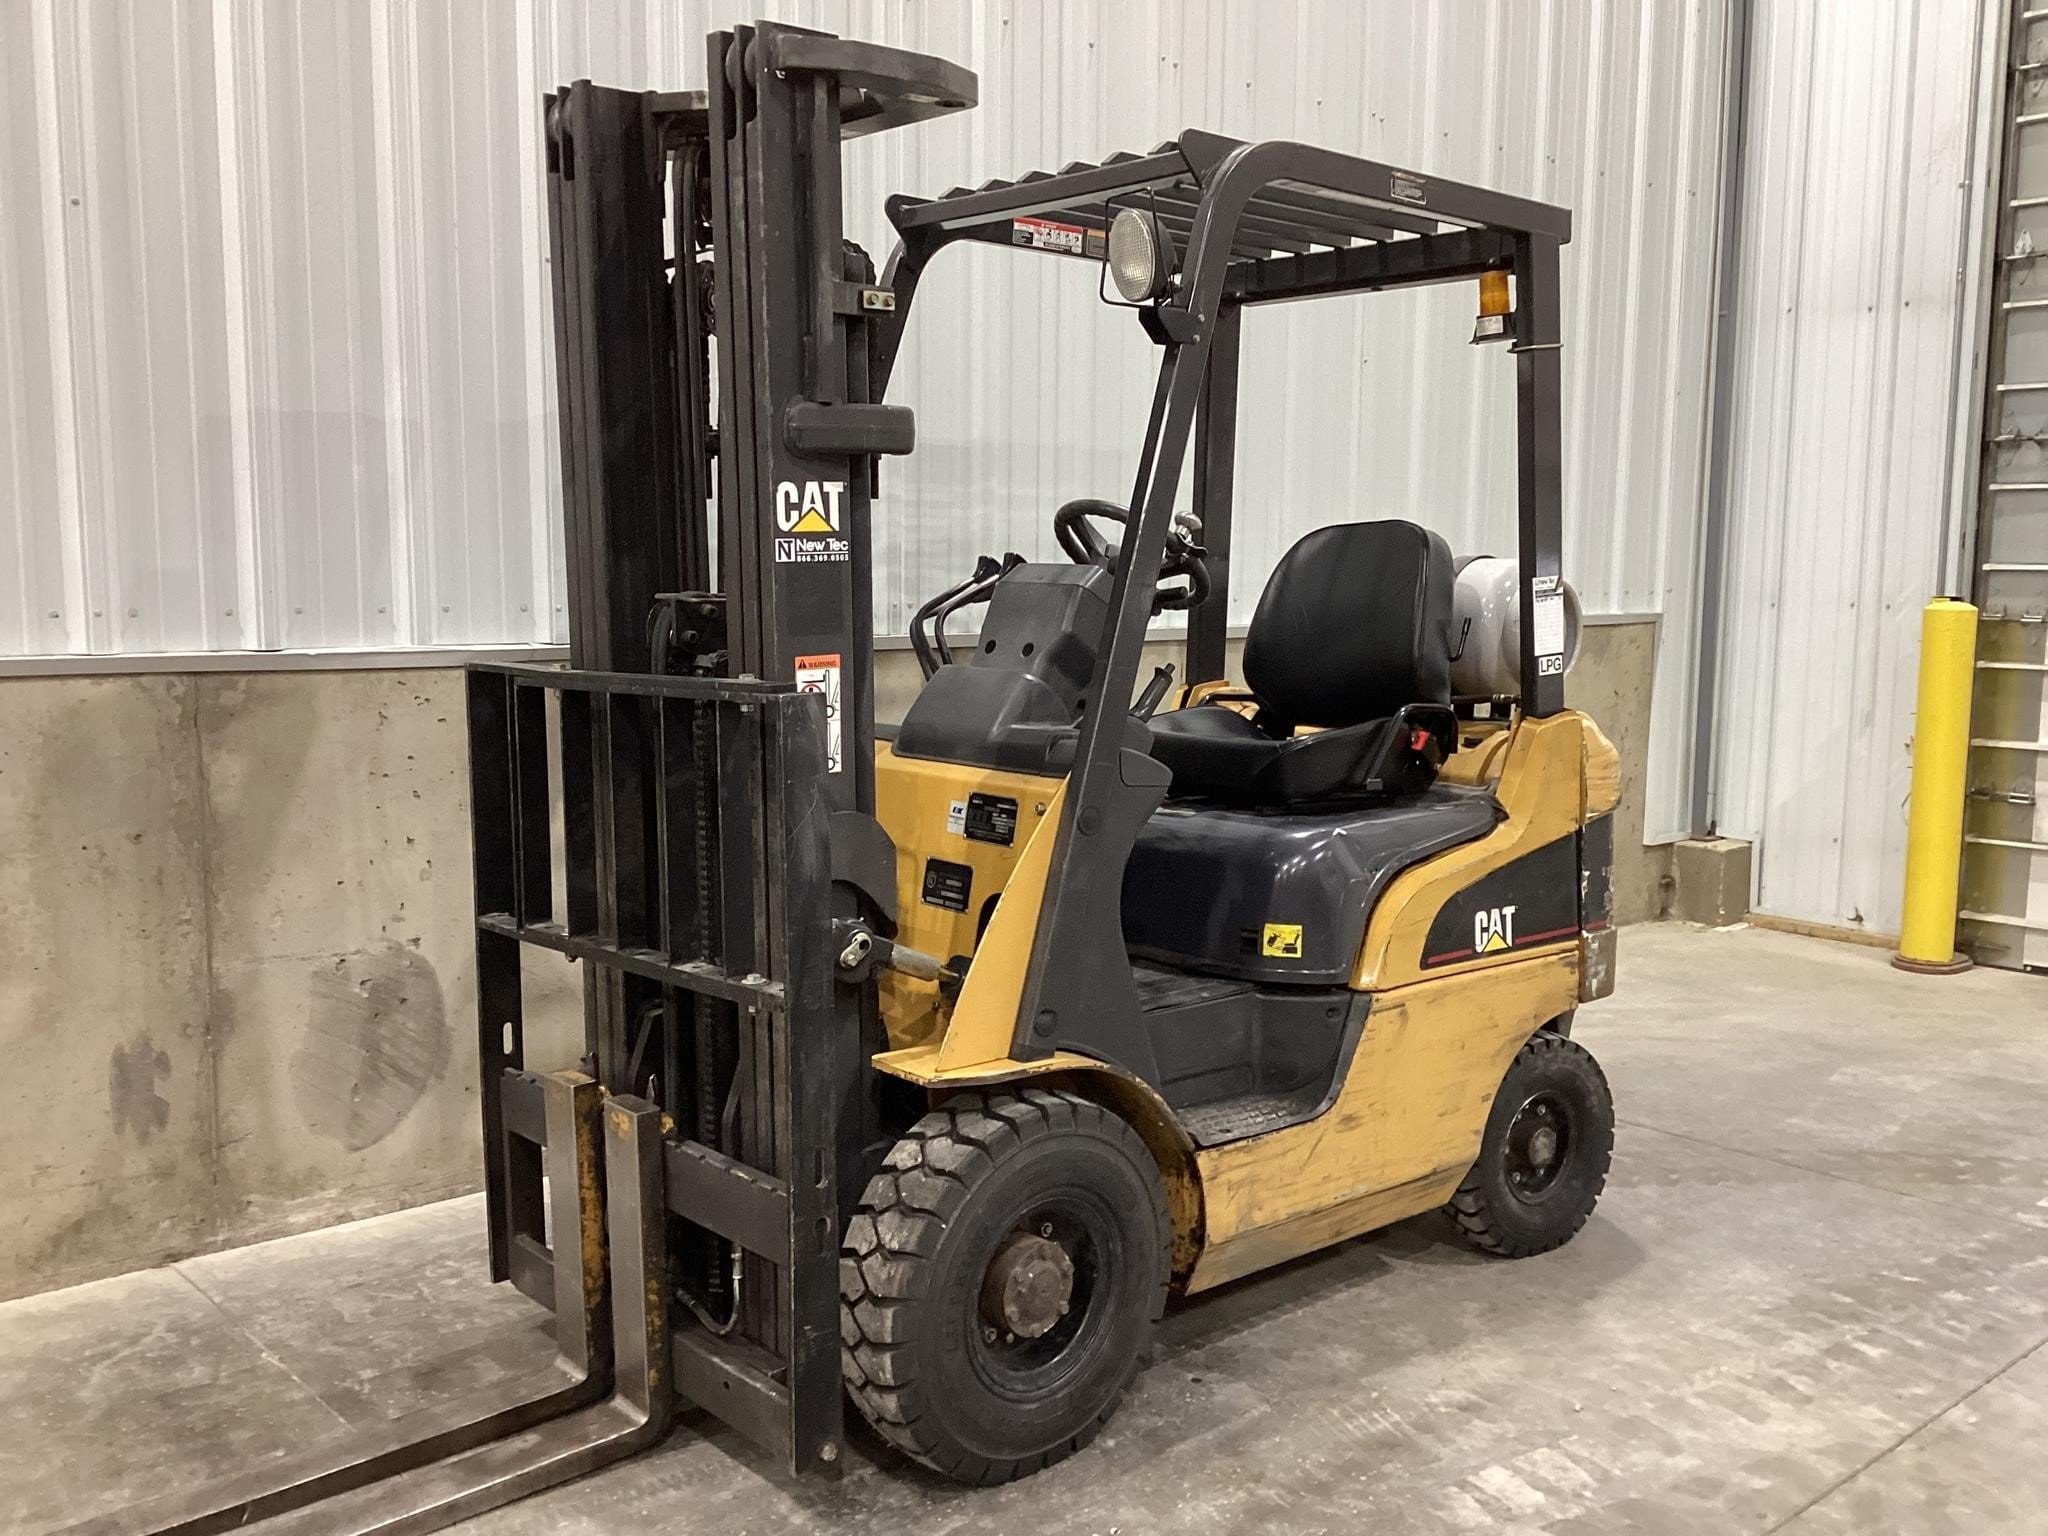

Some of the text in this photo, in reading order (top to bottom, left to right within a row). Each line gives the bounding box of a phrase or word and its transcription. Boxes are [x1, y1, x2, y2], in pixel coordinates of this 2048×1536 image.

[776, 481, 844, 532] CAT
[796, 538, 825, 551] New
[826, 538, 849, 551] Tec
[808, 660, 837, 669] WARNING
[1540, 657, 1562, 673] LPG
[1474, 905, 1516, 953] CAT
